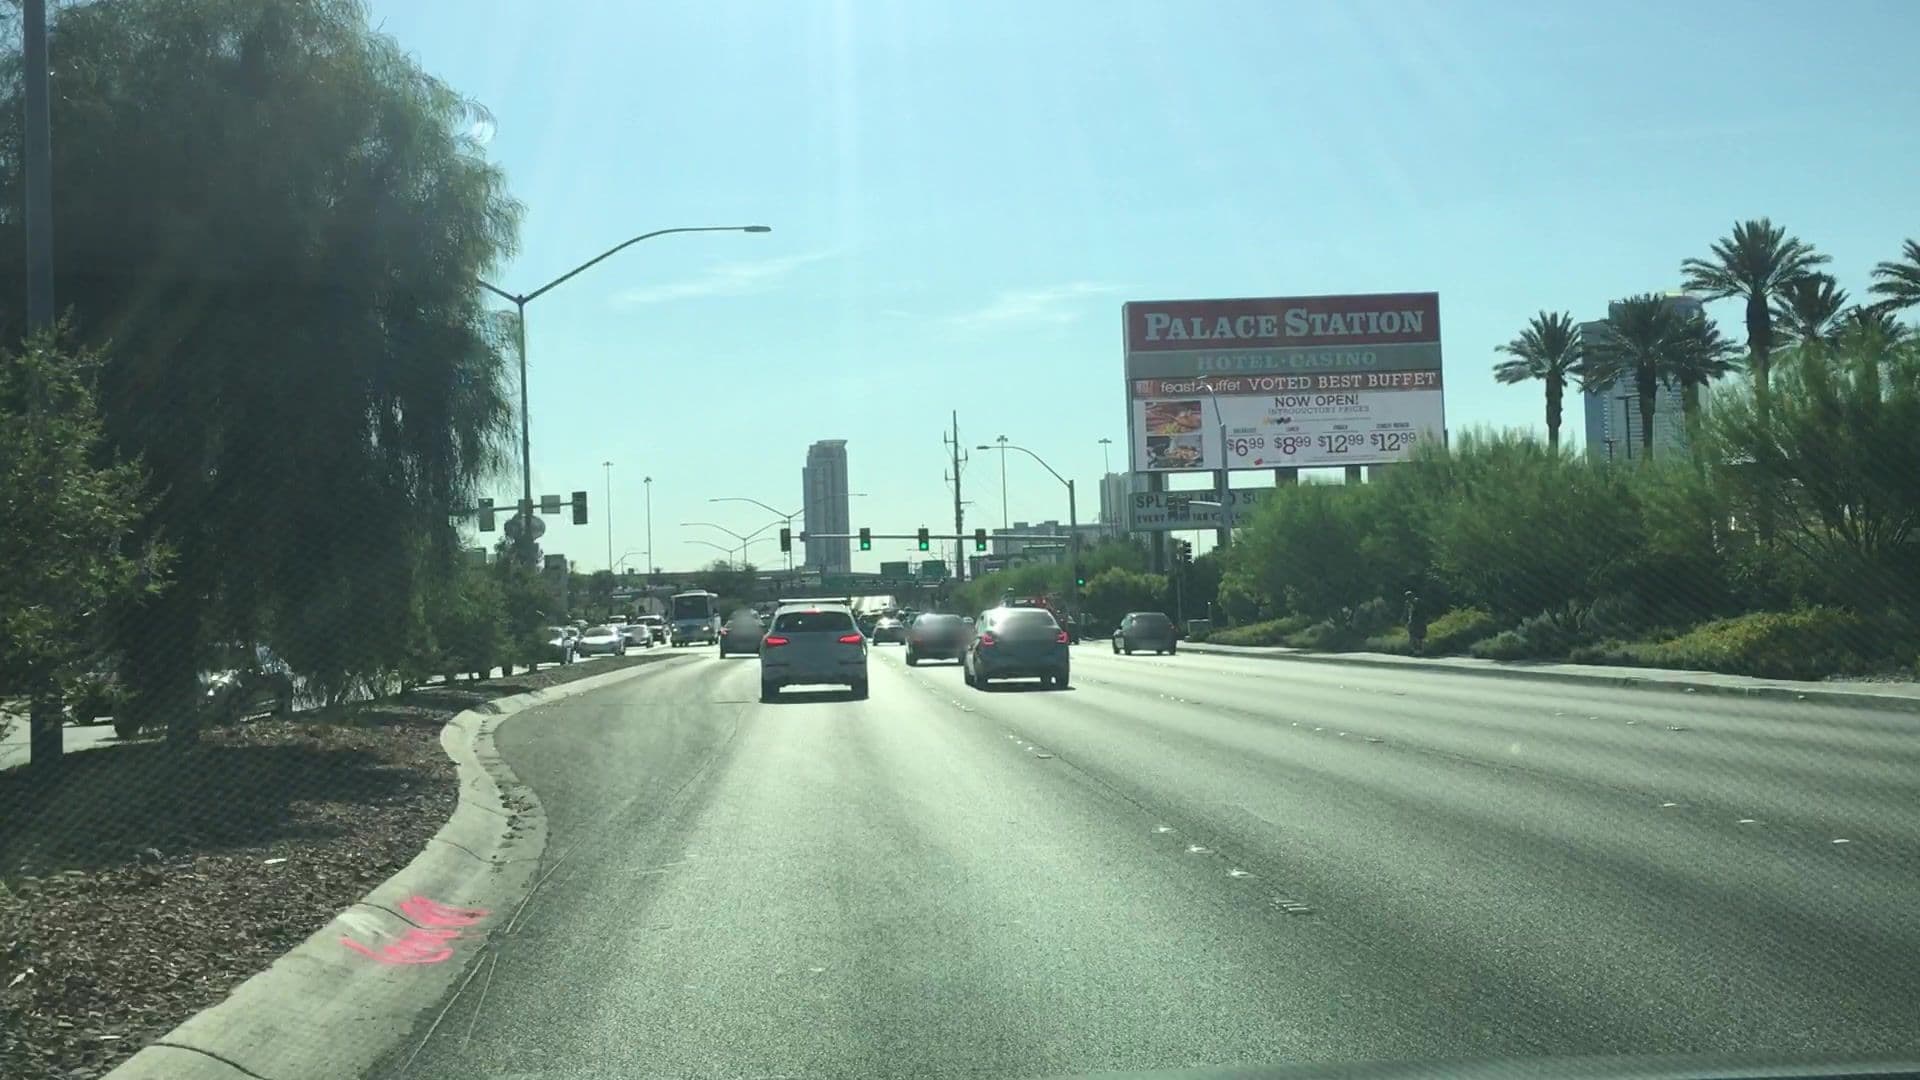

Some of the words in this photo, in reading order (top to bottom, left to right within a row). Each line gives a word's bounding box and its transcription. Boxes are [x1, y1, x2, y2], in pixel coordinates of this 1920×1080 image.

[1145, 312, 1278, 341] PALACE
[1285, 307, 1424, 337] STATION
[1197, 354, 1278, 371] HOTEL
[1288, 351, 1377, 368] CASINO
[1160, 381, 1195, 393] feast
[1248, 376, 1311, 391] VOTED
[1318, 375, 1362, 389] BEST
[1368, 373, 1436, 387] BUFFET
[1275, 395, 1311, 408] NOW
[1315, 394, 1359, 406] OPEN!
